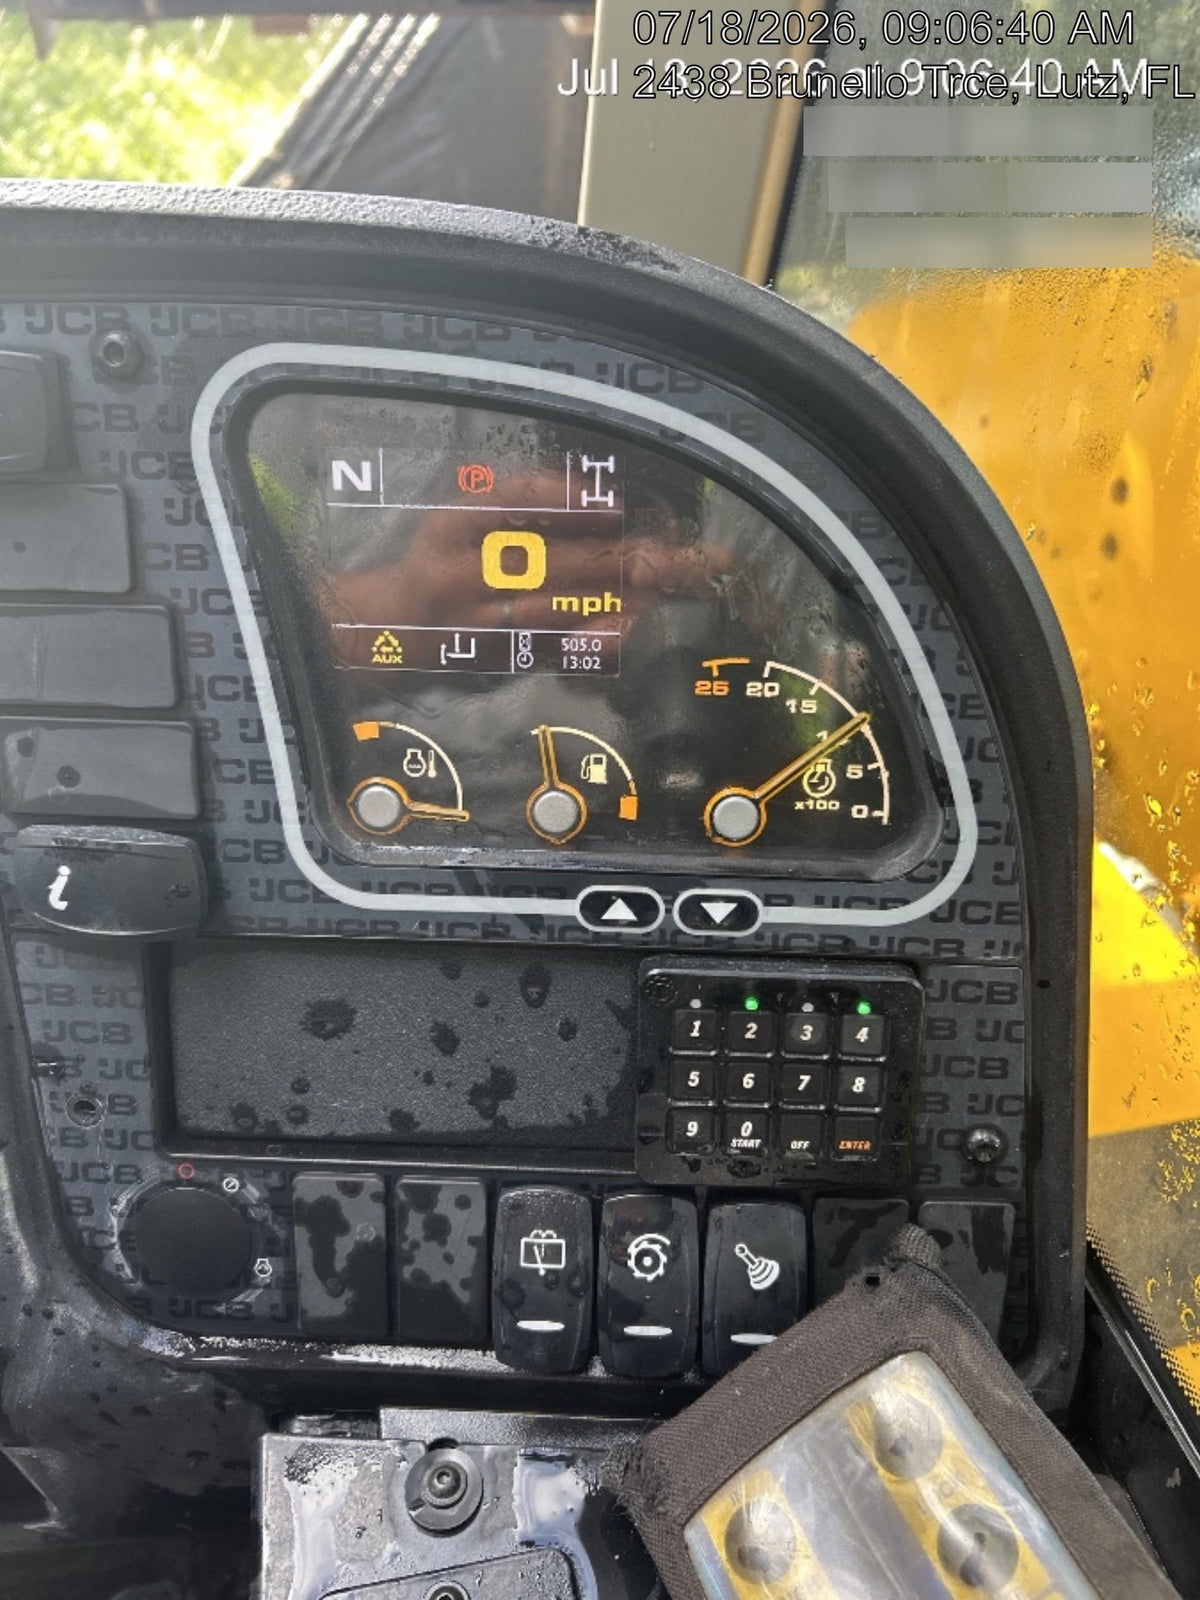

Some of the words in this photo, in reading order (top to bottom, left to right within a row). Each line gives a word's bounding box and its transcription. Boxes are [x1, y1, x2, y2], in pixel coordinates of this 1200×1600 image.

[331, 460, 373, 492] N
[551, 591, 622, 617] mph
[560, 637, 602, 653] 505.0
[371, 653, 404, 664] AUX
[561, 655, 602, 671] 13:02
[694, 681, 730, 697] 25
[745, 682, 780, 698] 20
[785, 699, 818, 714] 15
[846, 763, 863, 779] 5
[794, 800, 840, 811] x100
[851, 804, 869, 819] 0
[690, 1020, 701, 1037] 1
[744, 1022, 758, 1039] 2
[801, 1025, 814, 1041] 3
[855, 1027, 869, 1042] 4
[687, 1071, 700, 1087] 5
[742, 1073, 755, 1089] 6
[798, 1075, 811, 1091] 7
[852, 1077, 866, 1093] 8
[686, 1121, 698, 1137] 9
[741, 1121, 753, 1137] 0
[730, 1138, 762, 1148] START
[790, 1140, 810, 1149] OFF
[838, 1140, 872, 1150] ENTER
